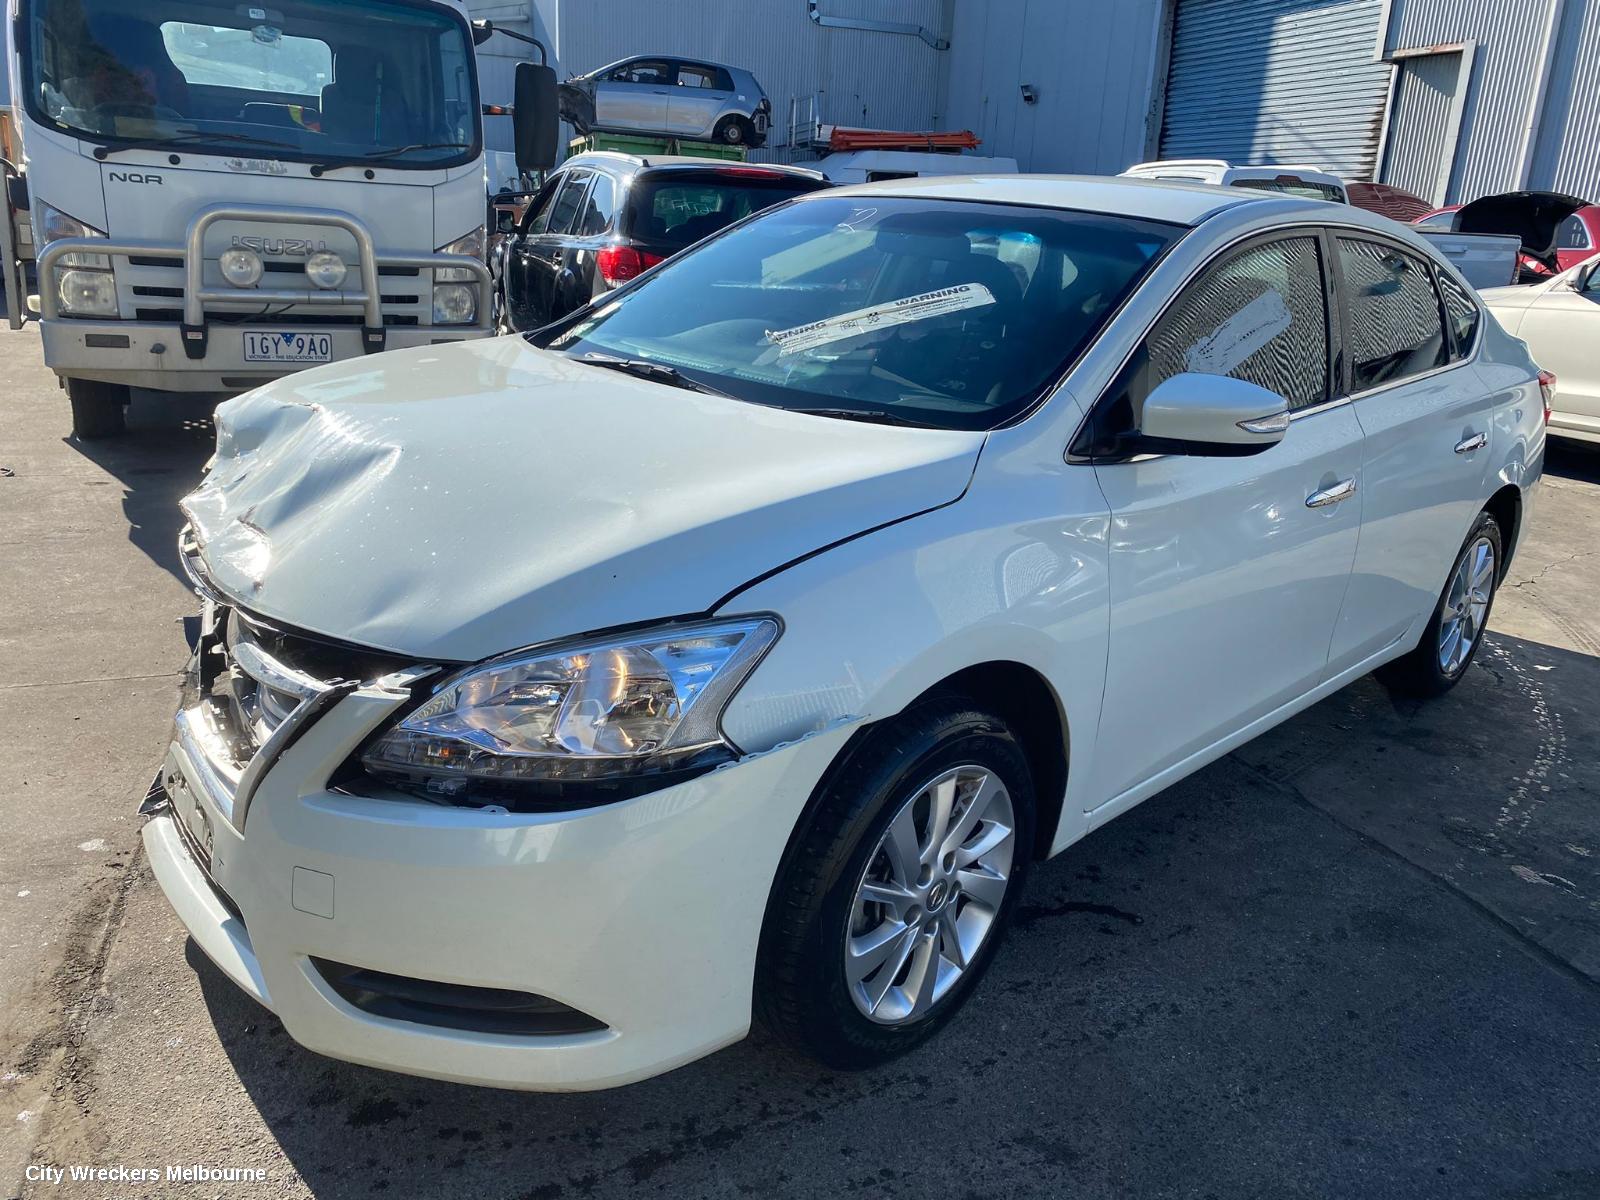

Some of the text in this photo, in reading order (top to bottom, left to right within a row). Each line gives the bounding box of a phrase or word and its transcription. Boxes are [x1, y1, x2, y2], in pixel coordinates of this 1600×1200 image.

[109, 172, 163, 185] NQR
[231, 235, 327, 256] ISUZU
[895, 285, 971, 307] WARNING
[249, 336, 281, 355] 1GY
